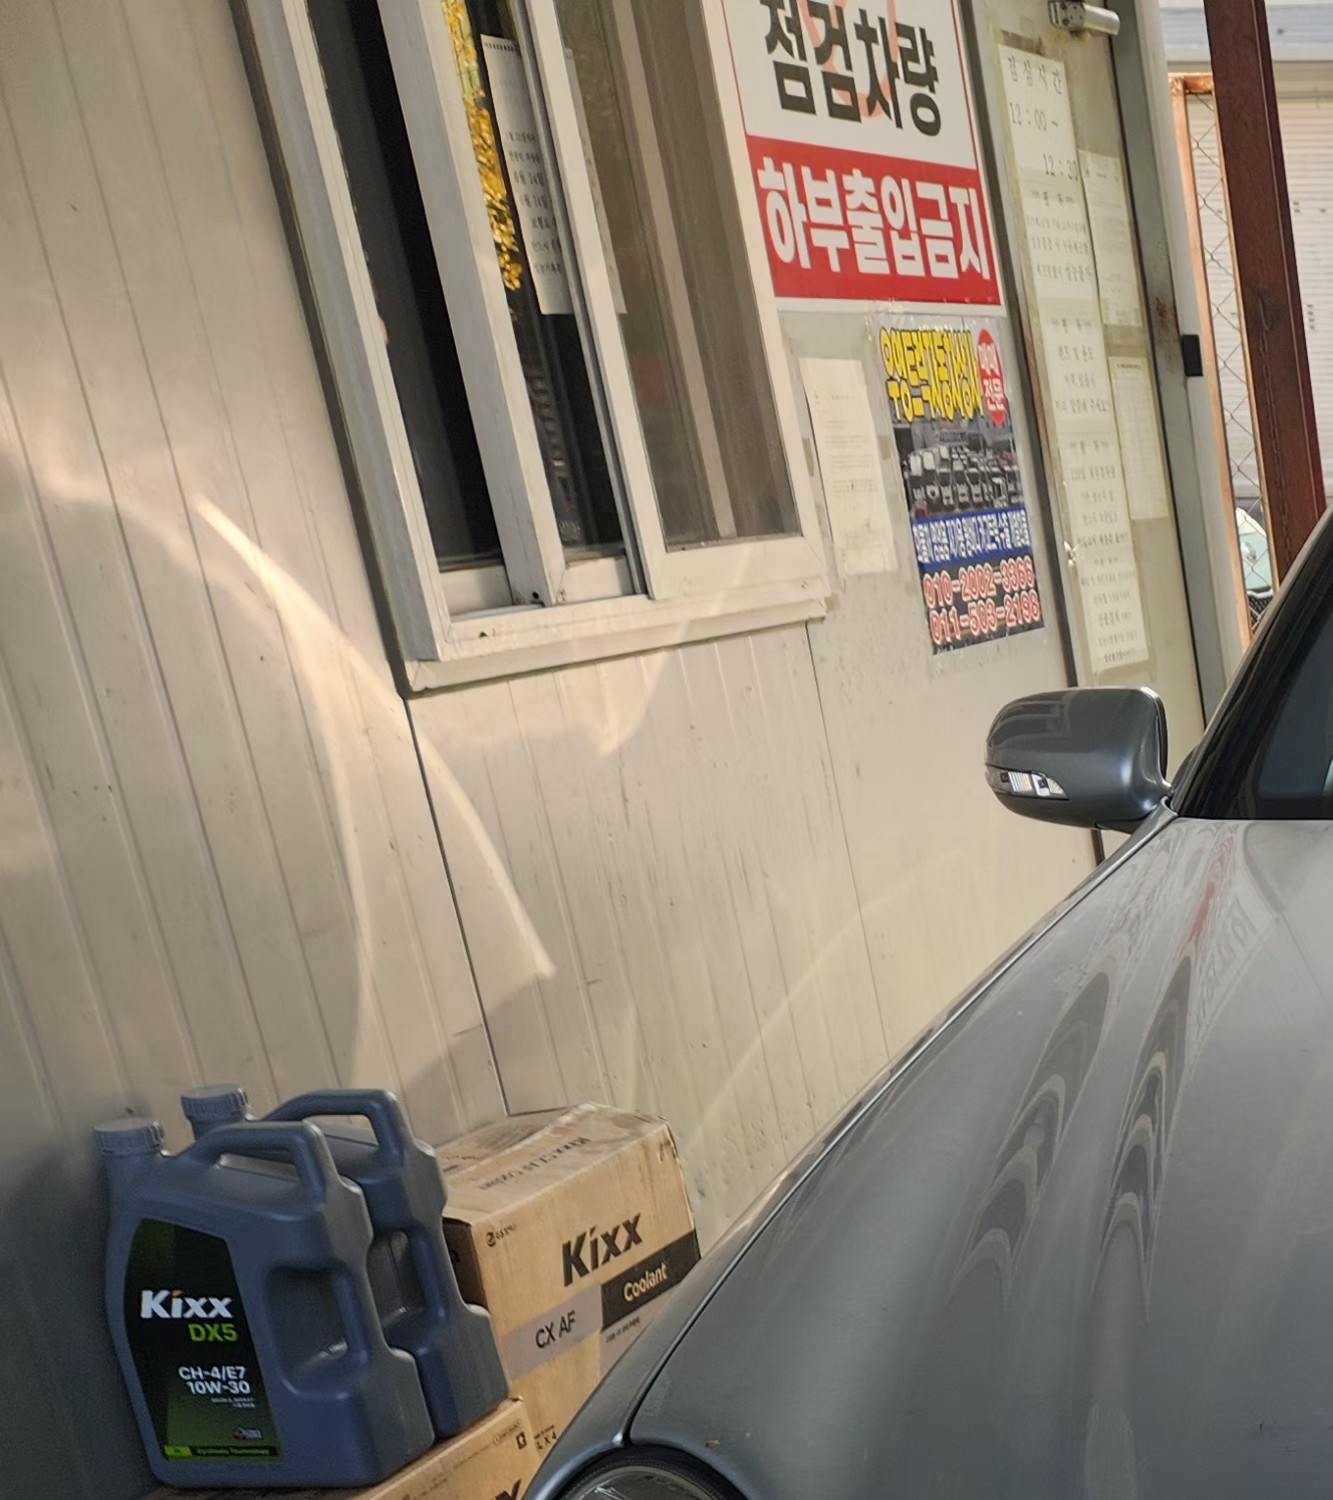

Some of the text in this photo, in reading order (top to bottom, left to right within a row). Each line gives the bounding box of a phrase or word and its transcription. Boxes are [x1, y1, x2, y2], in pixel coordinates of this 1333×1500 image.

[765, 0, 941, 137] 점검차량
[757, 157, 990, 280] 하부출입금지
[562, 1212, 644, 1288] Kixx
[623, 1263, 668, 1302] Coolant
[140, 1289, 234, 1319] Kixx
[187, 1323, 238, 1342] DX5
[535, 1325, 556, 1349] CX
[558, 1310, 577, 1338] AF
[177, 1365, 247, 1380] CH-4/E7
[186, 1380, 251, 1395] 10W-30
